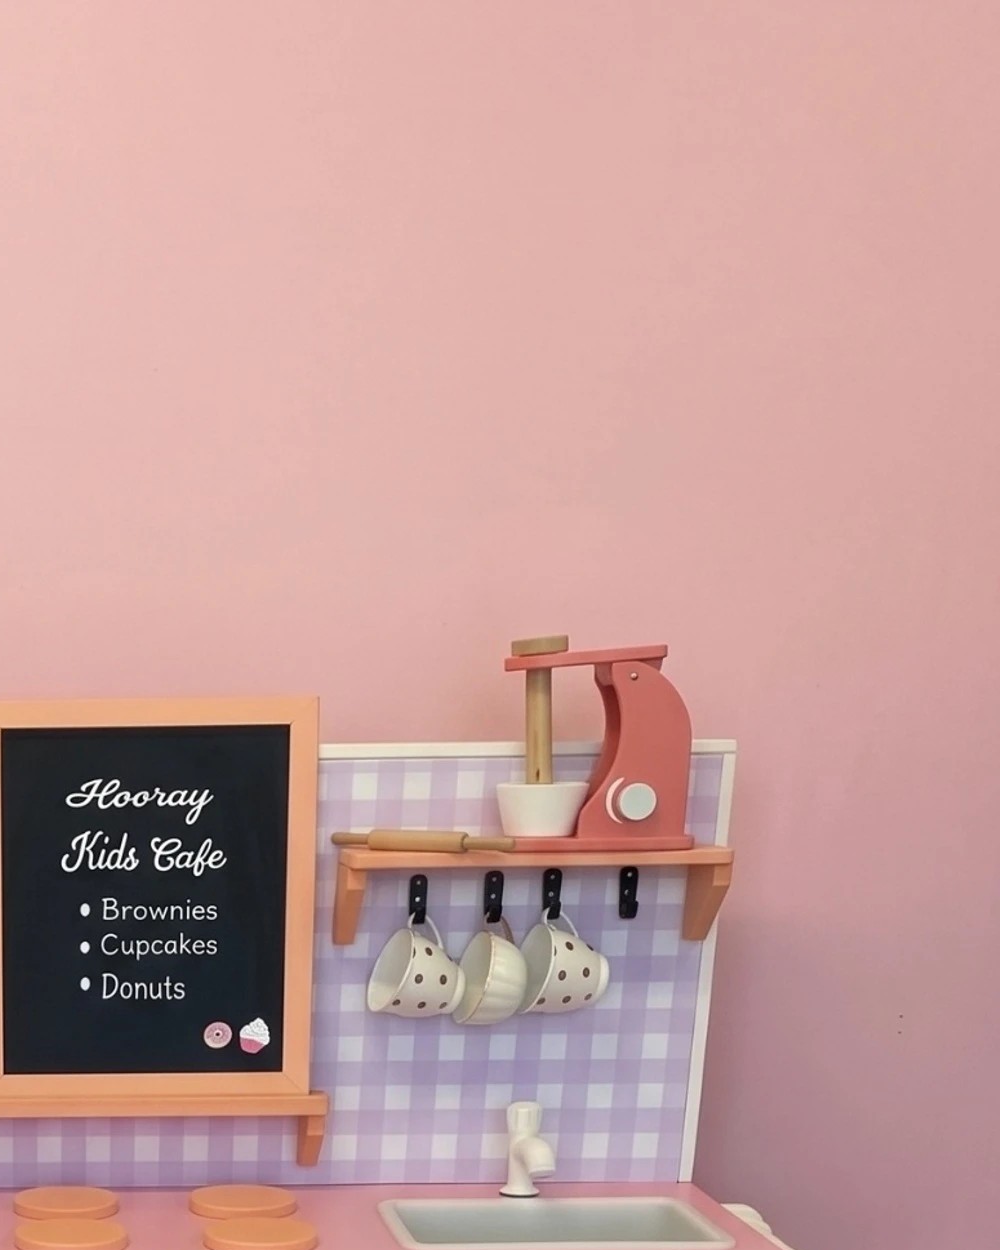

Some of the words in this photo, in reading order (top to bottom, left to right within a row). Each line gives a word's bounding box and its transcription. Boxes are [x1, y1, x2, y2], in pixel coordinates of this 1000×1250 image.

[64, 778, 215, 826] Hooray
[60, 830, 140, 873] Kids
[150, 836, 228, 877] Cafe
[101, 897, 219, 921] Brownies
[100, 932, 218, 961] Cupcakes
[101, 972, 187, 1001] Donuts
